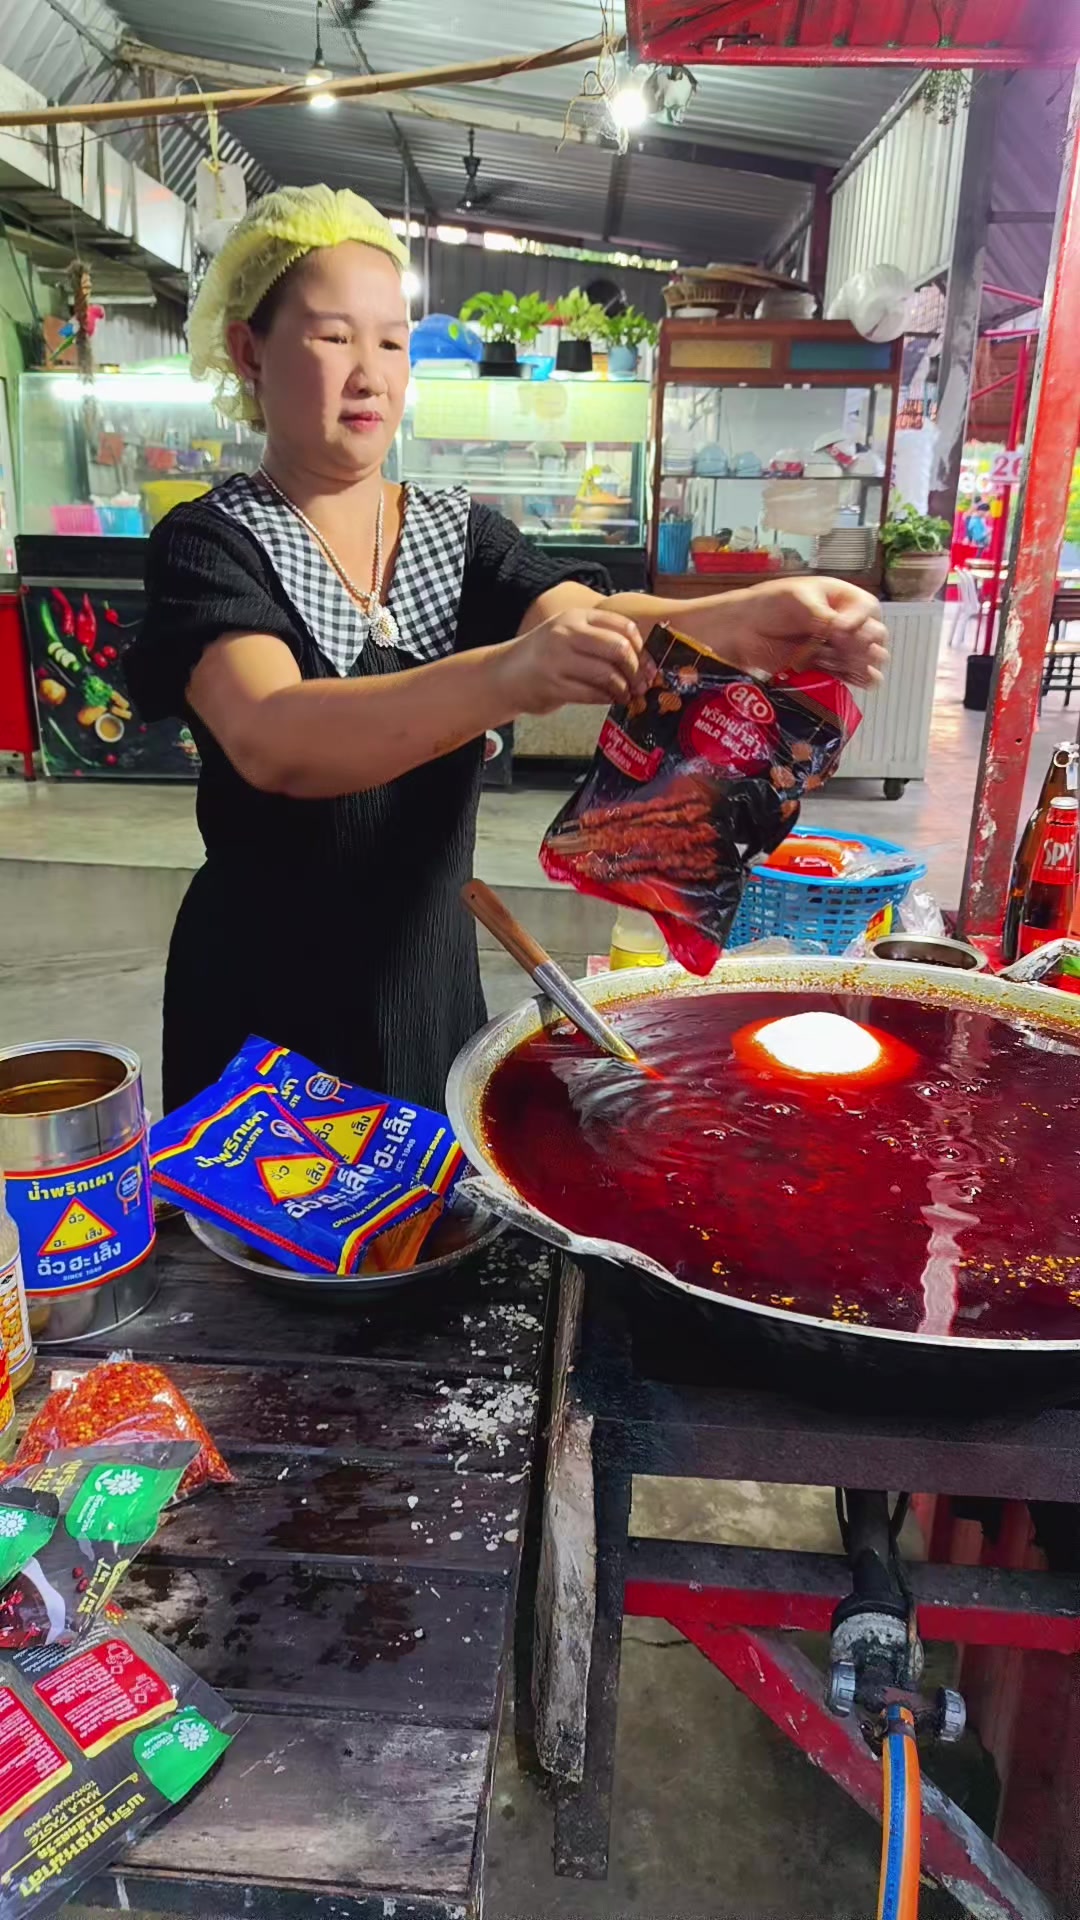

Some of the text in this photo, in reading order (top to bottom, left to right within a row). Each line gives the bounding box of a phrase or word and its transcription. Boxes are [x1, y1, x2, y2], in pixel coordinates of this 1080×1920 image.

[731, 686, 769, 719] aro
[694, 719, 722, 740] MALA
[1043, 837, 1075, 867] SPY
[28, 1172, 115, 1201] น้ำพริกเผา
[29, 1786, 102, 1848] MALA PASTE
